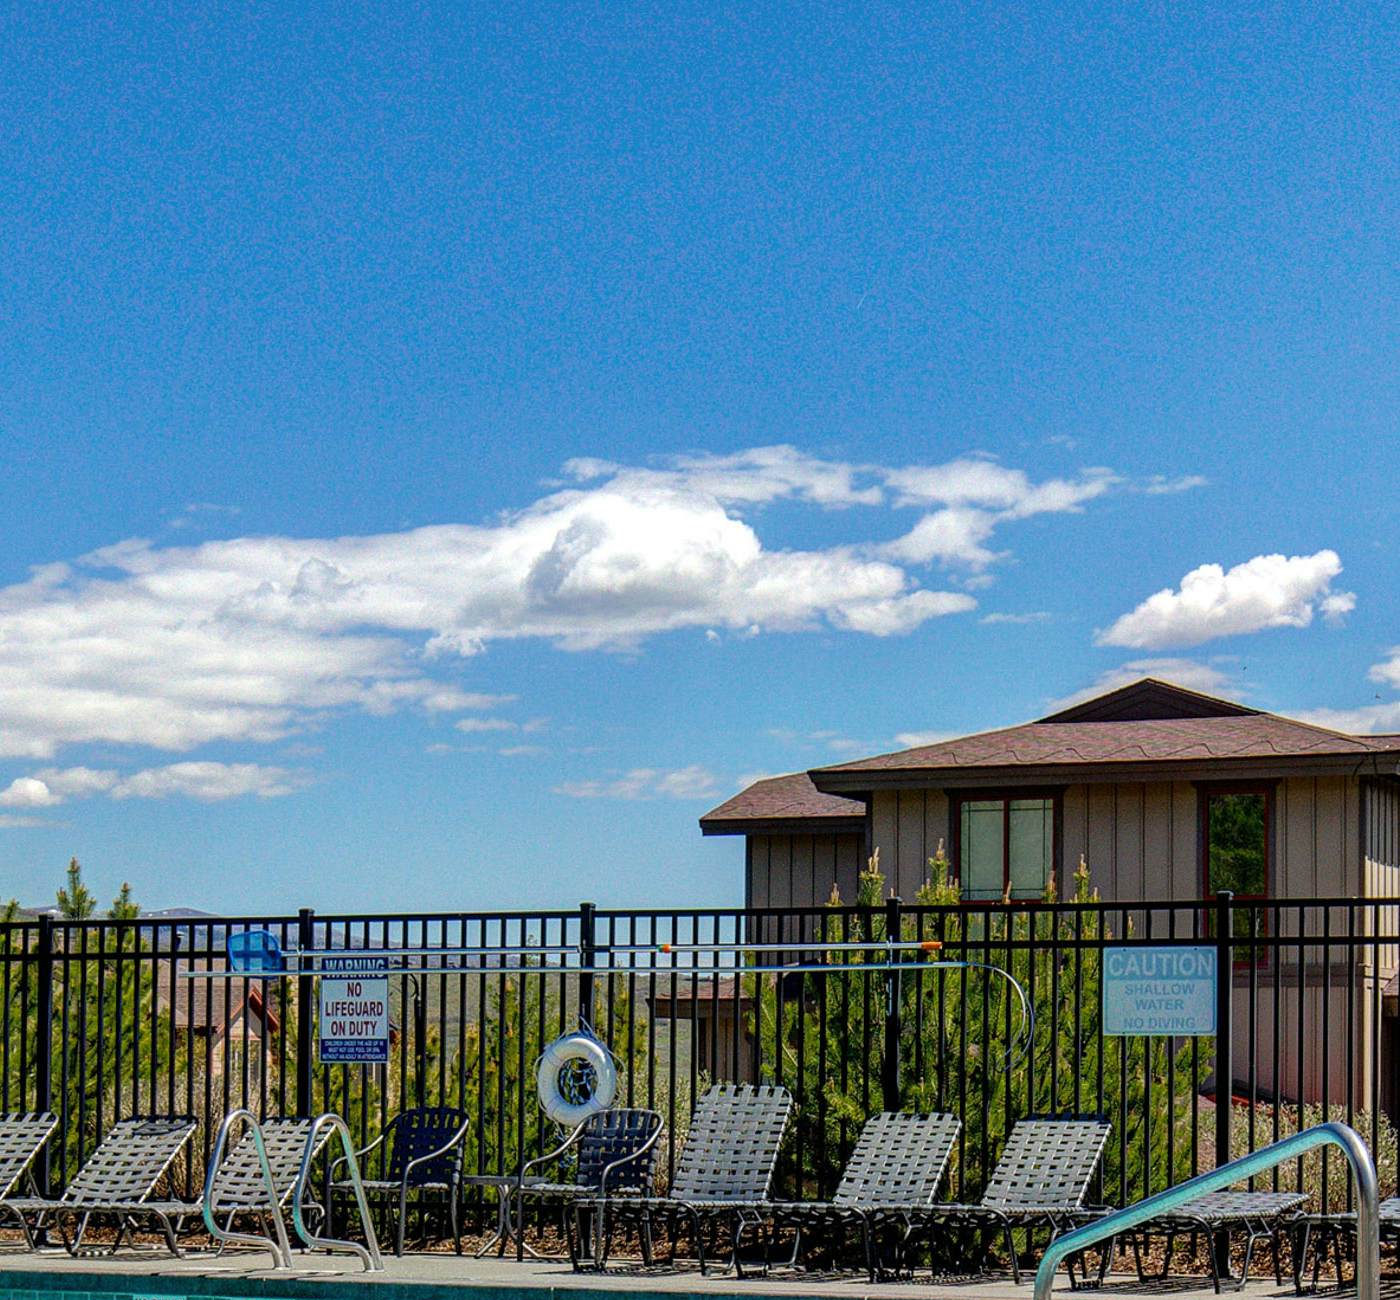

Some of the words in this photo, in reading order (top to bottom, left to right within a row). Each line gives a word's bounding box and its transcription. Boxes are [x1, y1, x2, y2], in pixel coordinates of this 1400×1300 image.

[325, 958, 385, 978] WARNING
[1108, 952, 1213, 976] CAUTION
[346, 982, 362, 997] NO
[1124, 983, 1195, 996] SHALLOW
[325, 1001, 384, 1017] LIFEGUARD
[1135, 999, 1185, 1011] WATER
[330, 1021, 346, 1036] ON
[349, 1021, 377, 1036] DUTY
[1124, 1017, 1144, 1029] NO
[1148, 1017, 1196, 1029] DIVING
